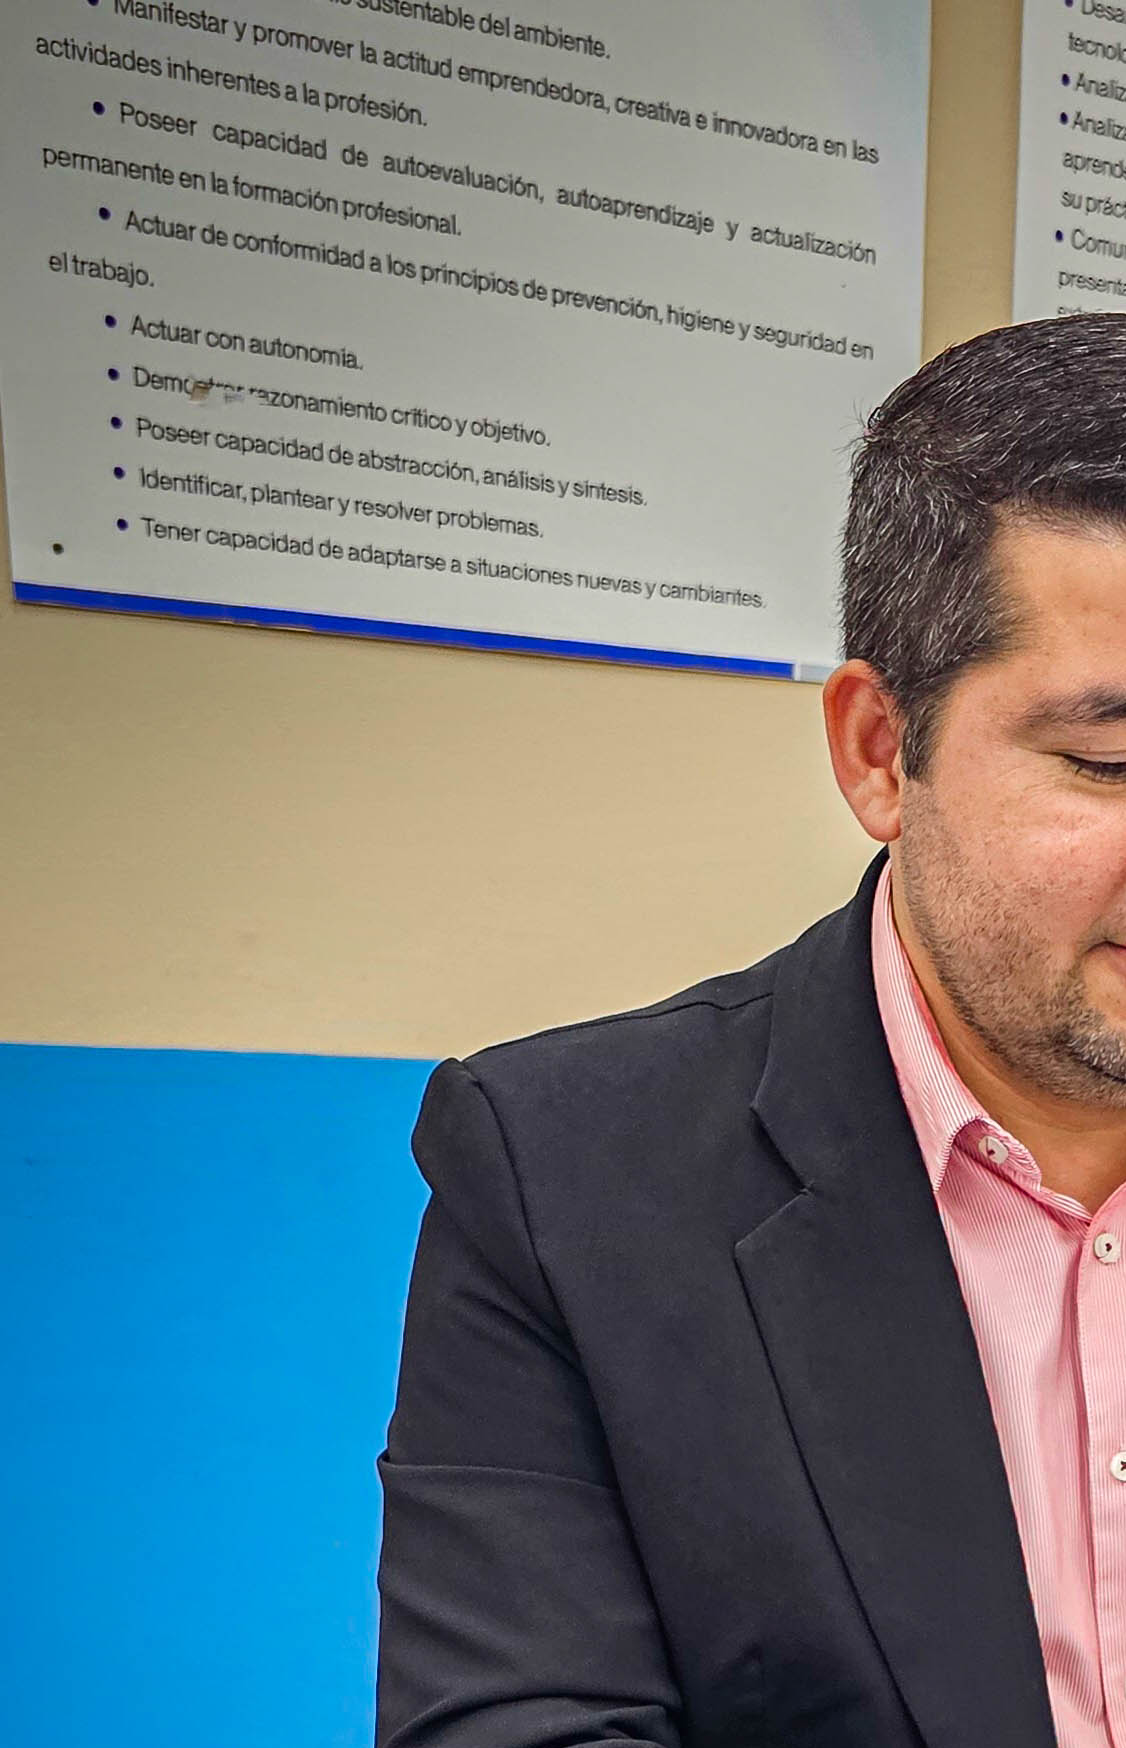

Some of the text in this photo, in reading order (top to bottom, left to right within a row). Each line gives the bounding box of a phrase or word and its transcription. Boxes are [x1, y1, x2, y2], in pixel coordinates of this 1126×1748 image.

[36, 37, 427, 127] actividades inherentes a la profesión.
[114, 0, 880, 164] Manifestar y promover la actitud emprendedora, creativa e innovadora en las
[119, 101, 876, 265] Poseer capacidad de autoevaluación, autoaprendizaje y actualización
[48, 251, 154, 288] el trabajo.
[124, 210, 874, 360] Actuar de conformidad a los principios de prevención, higiene y seguridad en
[130, 314, 202, 345] Actuar
[204, 331, 245, 352] con
[136, 417, 211, 447] Poseer
[214, 433, 324, 462] capacidad
[326, 444, 354, 466] de
[357, 449, 480, 486] abstracción,
[482, 468, 555, 494] análisis
[557, 480, 570, 498] y
[454, 418, 468, 438] y
[469, 418, 551, 447] objetivo.
[139, 467, 544, 538] Identificar, plantear y resolver problemas.
[140, 516, 202, 543] Tener
[204, 529, 314, 556] capacidad
[318, 538, 344, 560] de
[347, 544, 447, 572] adaptarse
[450, 558, 463, 574] a
[466, 557, 574, 587] situaciones
[576, 573, 643, 595] nuevas
[644, 582, 657, 600] y
